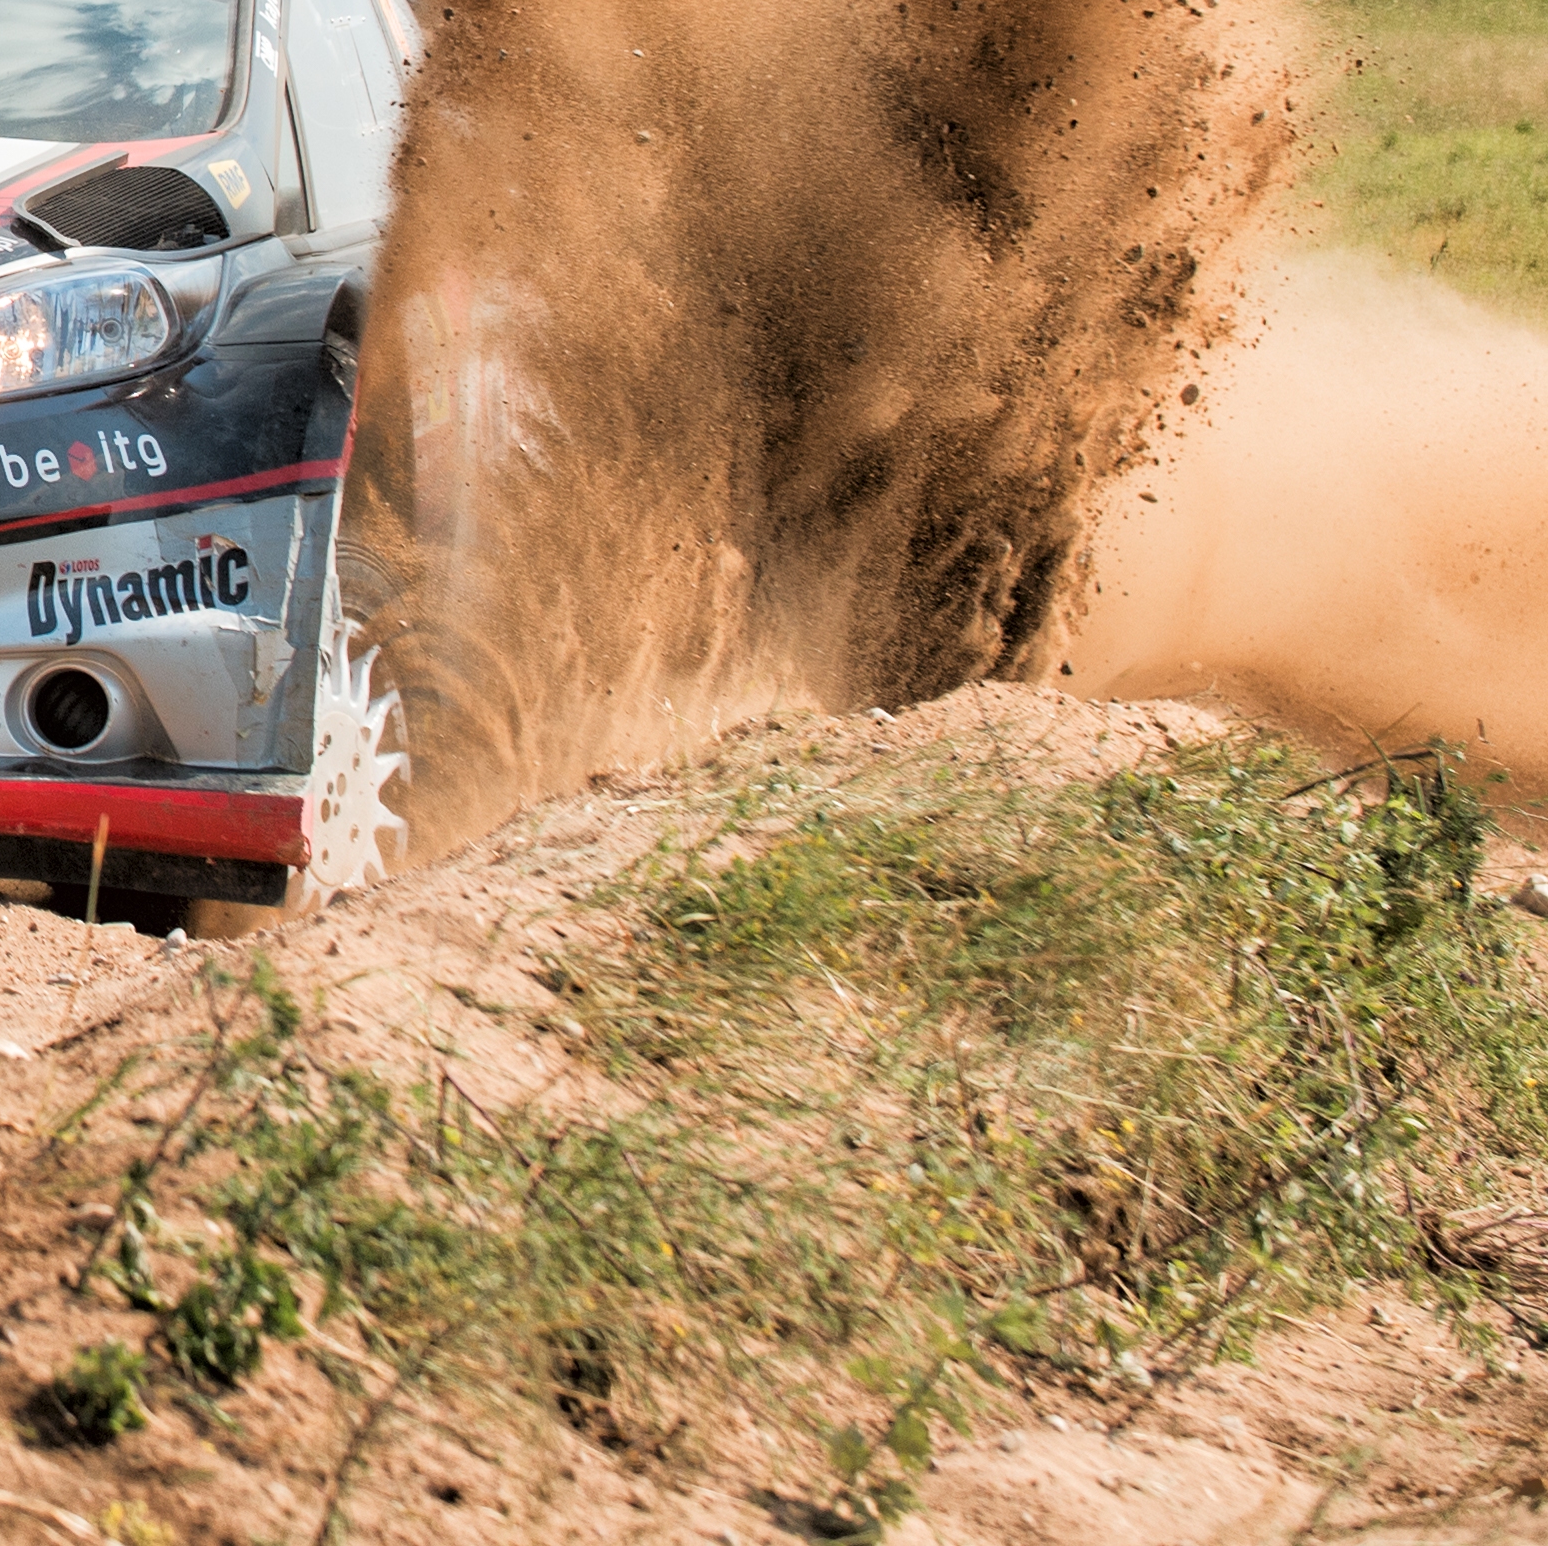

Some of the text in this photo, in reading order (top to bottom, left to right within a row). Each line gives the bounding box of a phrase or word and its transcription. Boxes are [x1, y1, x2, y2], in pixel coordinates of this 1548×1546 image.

[97, 430, 168, 478] itg
[71, 558, 101, 574] LOTOS
[27, 535, 249, 646] Dynamic
